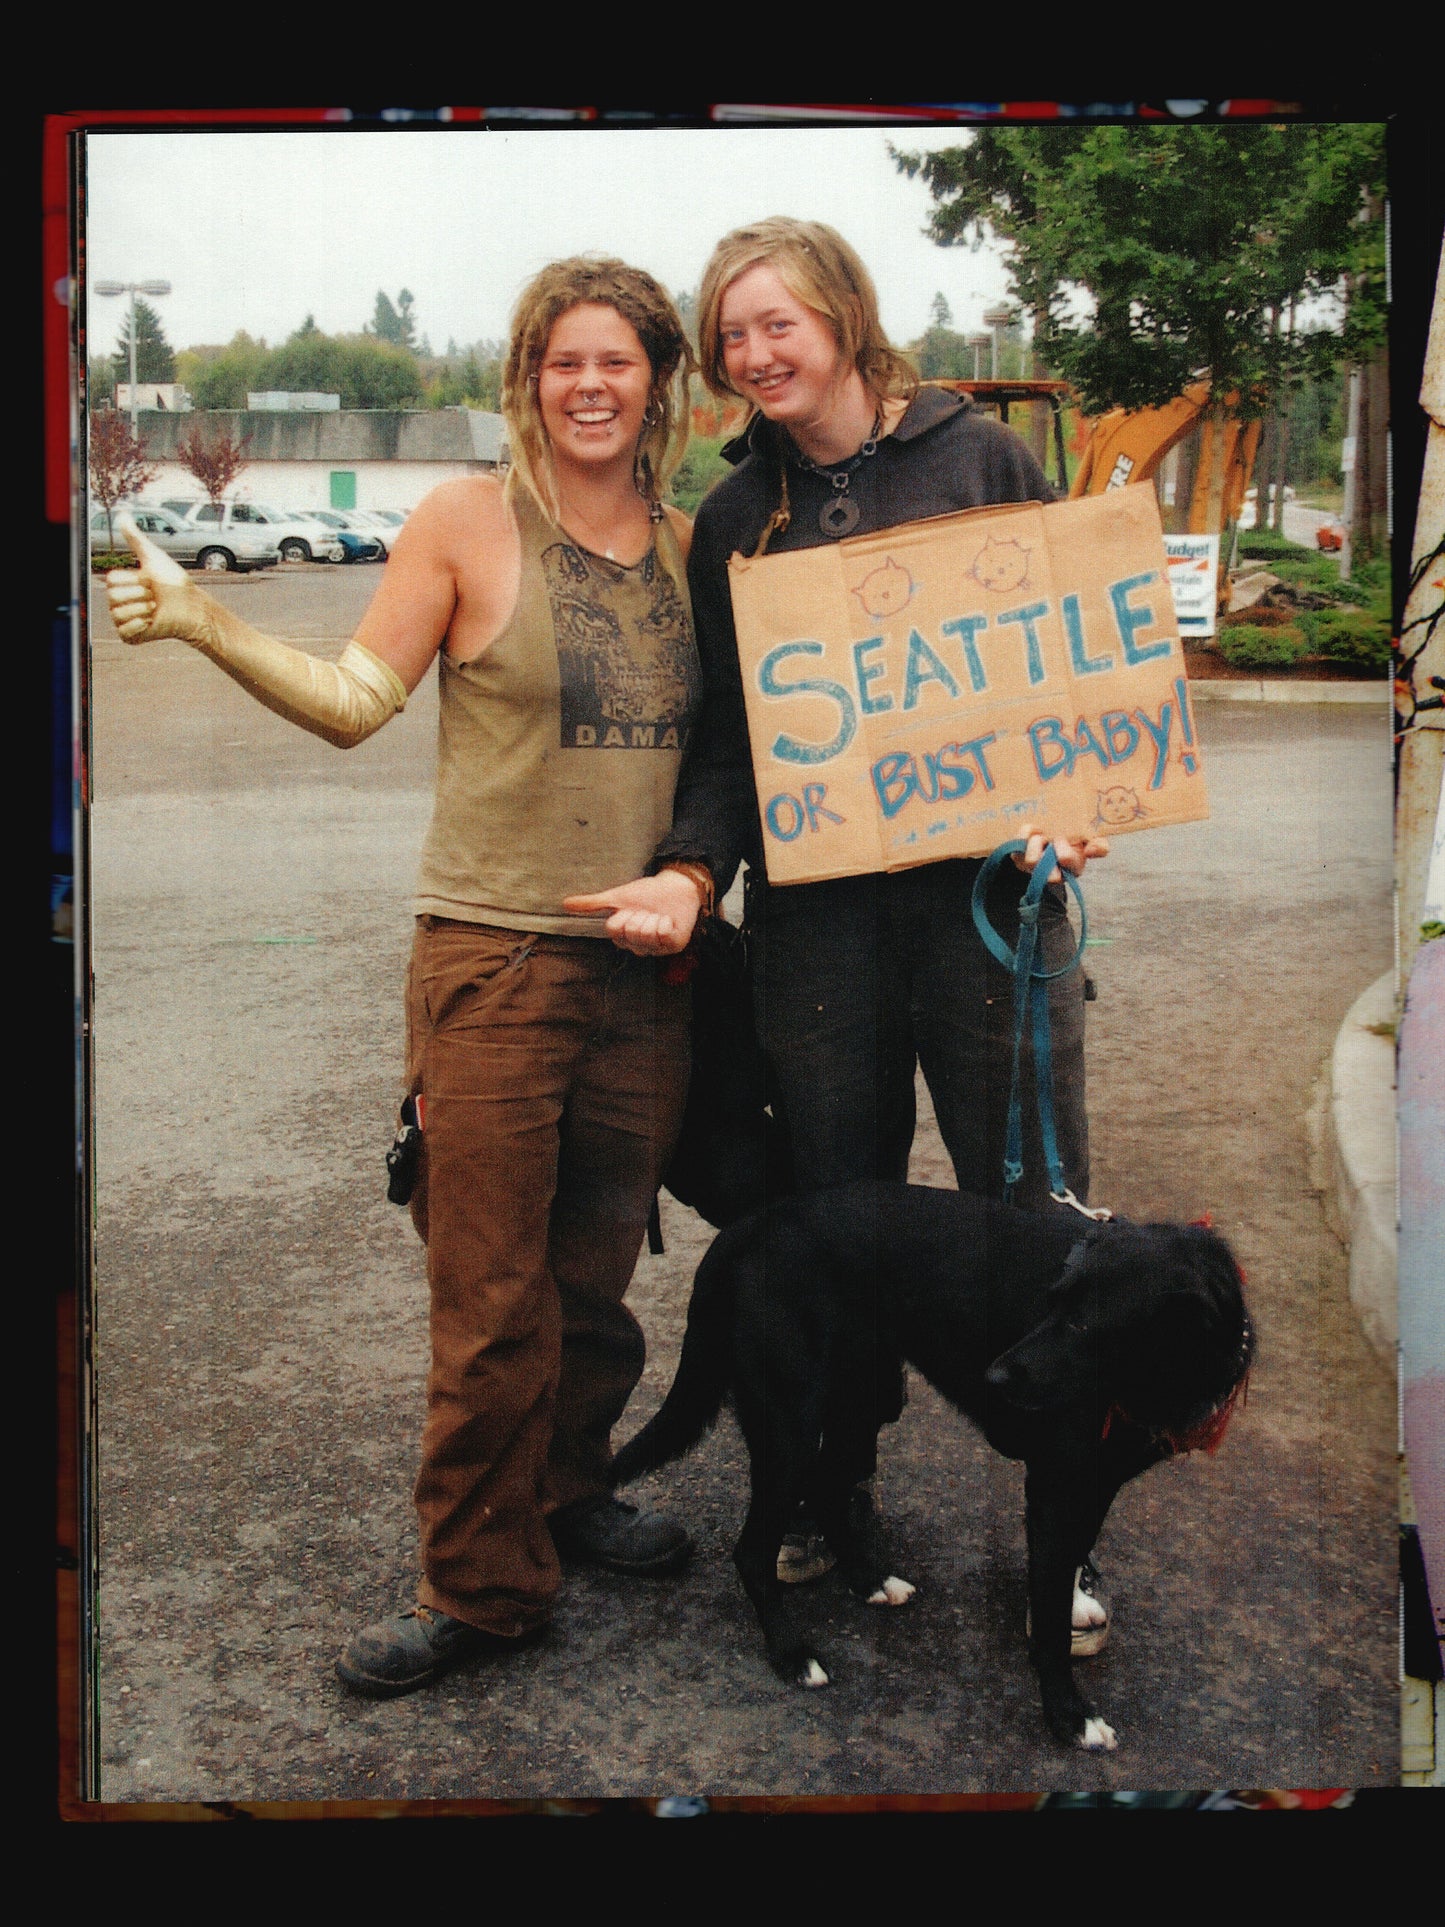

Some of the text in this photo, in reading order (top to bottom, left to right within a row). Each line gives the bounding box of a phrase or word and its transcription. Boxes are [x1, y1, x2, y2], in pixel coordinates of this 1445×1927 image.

[1165, 543, 1210, 559] udget
[757, 570, 1174, 766] SEATTLE
[575, 724, 688, 748] DAMA
[765, 782, 845, 843] OR
[870, 731, 997, 820] BUST
[1028, 677, 1198, 791] BABY!
